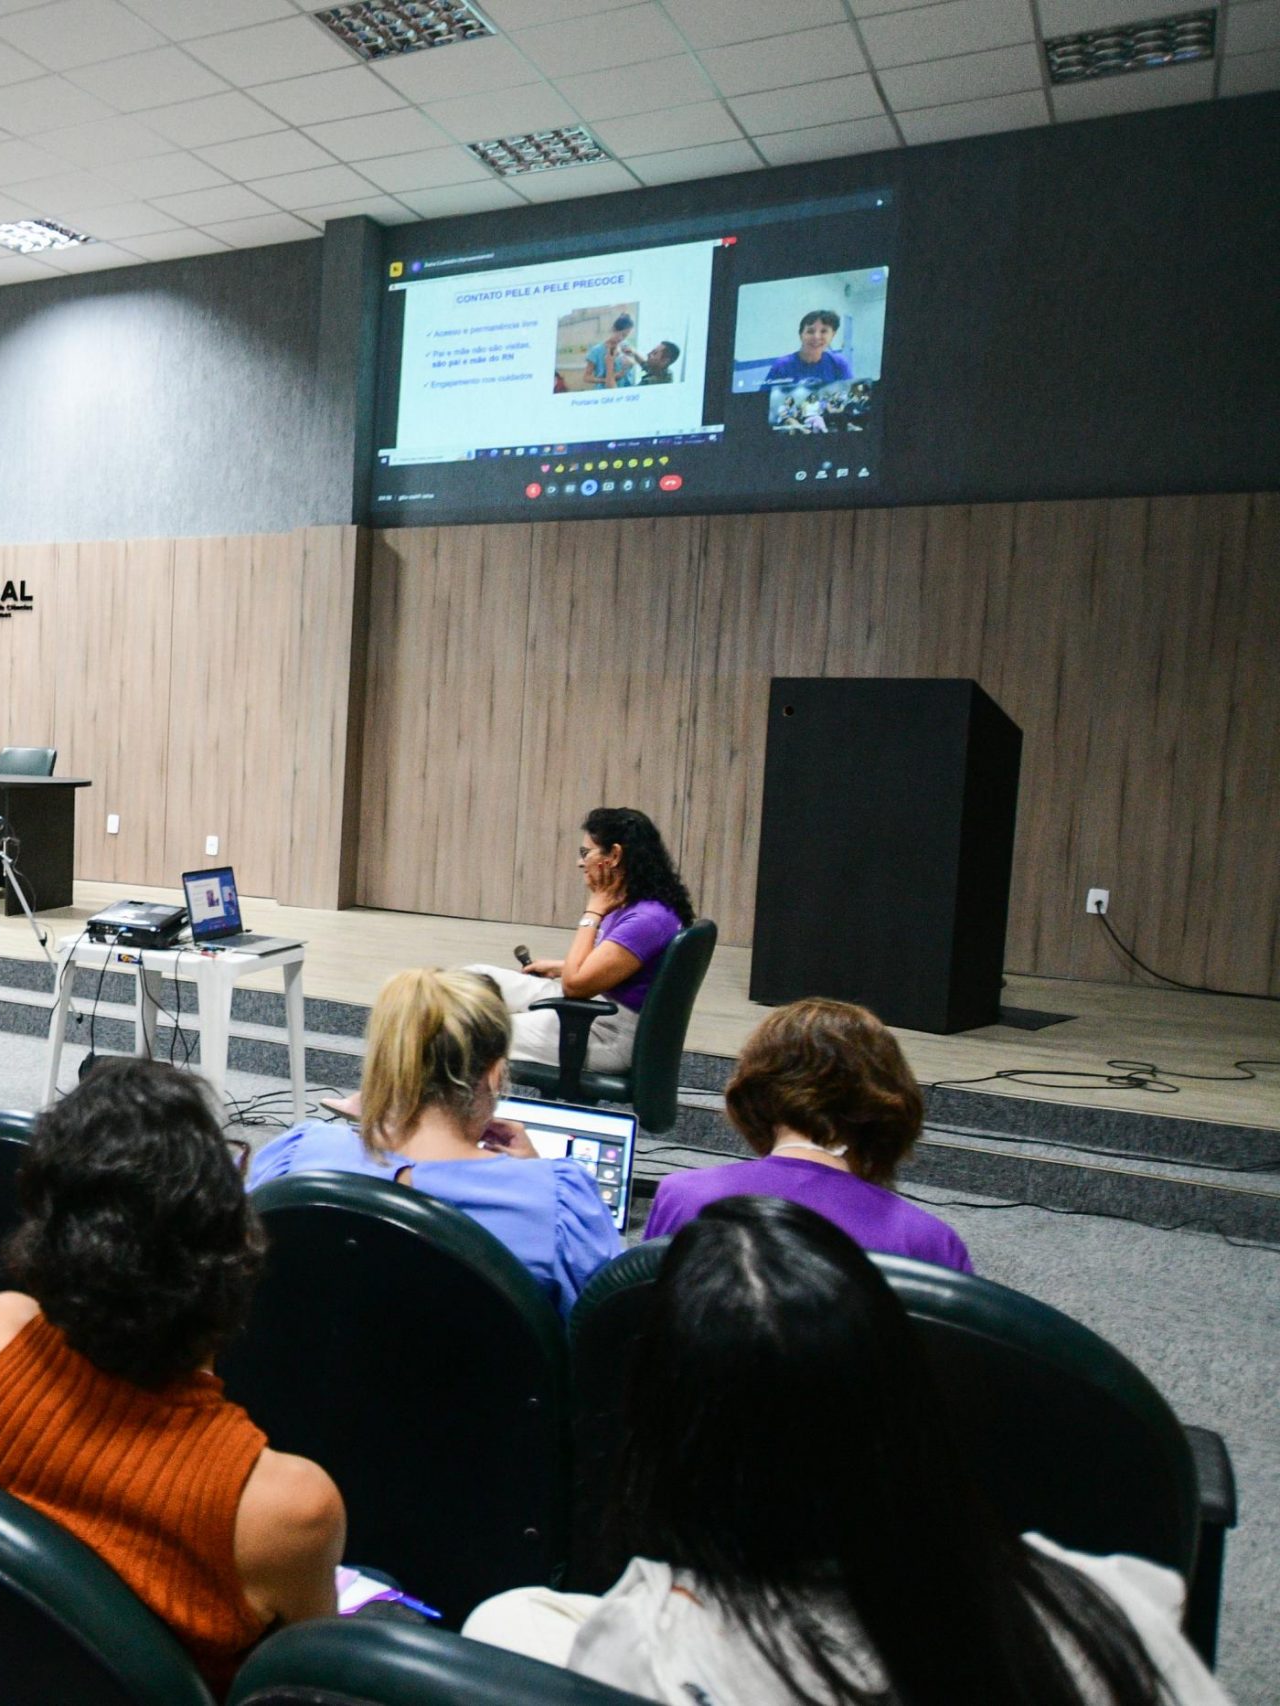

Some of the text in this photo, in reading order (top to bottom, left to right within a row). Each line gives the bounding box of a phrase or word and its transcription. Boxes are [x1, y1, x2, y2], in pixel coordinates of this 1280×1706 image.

[456, 274, 625, 304] CONTATO PELE A PELE PRECOCE
[489, 353, 500, 362] do
[501, 352, 515, 362] RN
